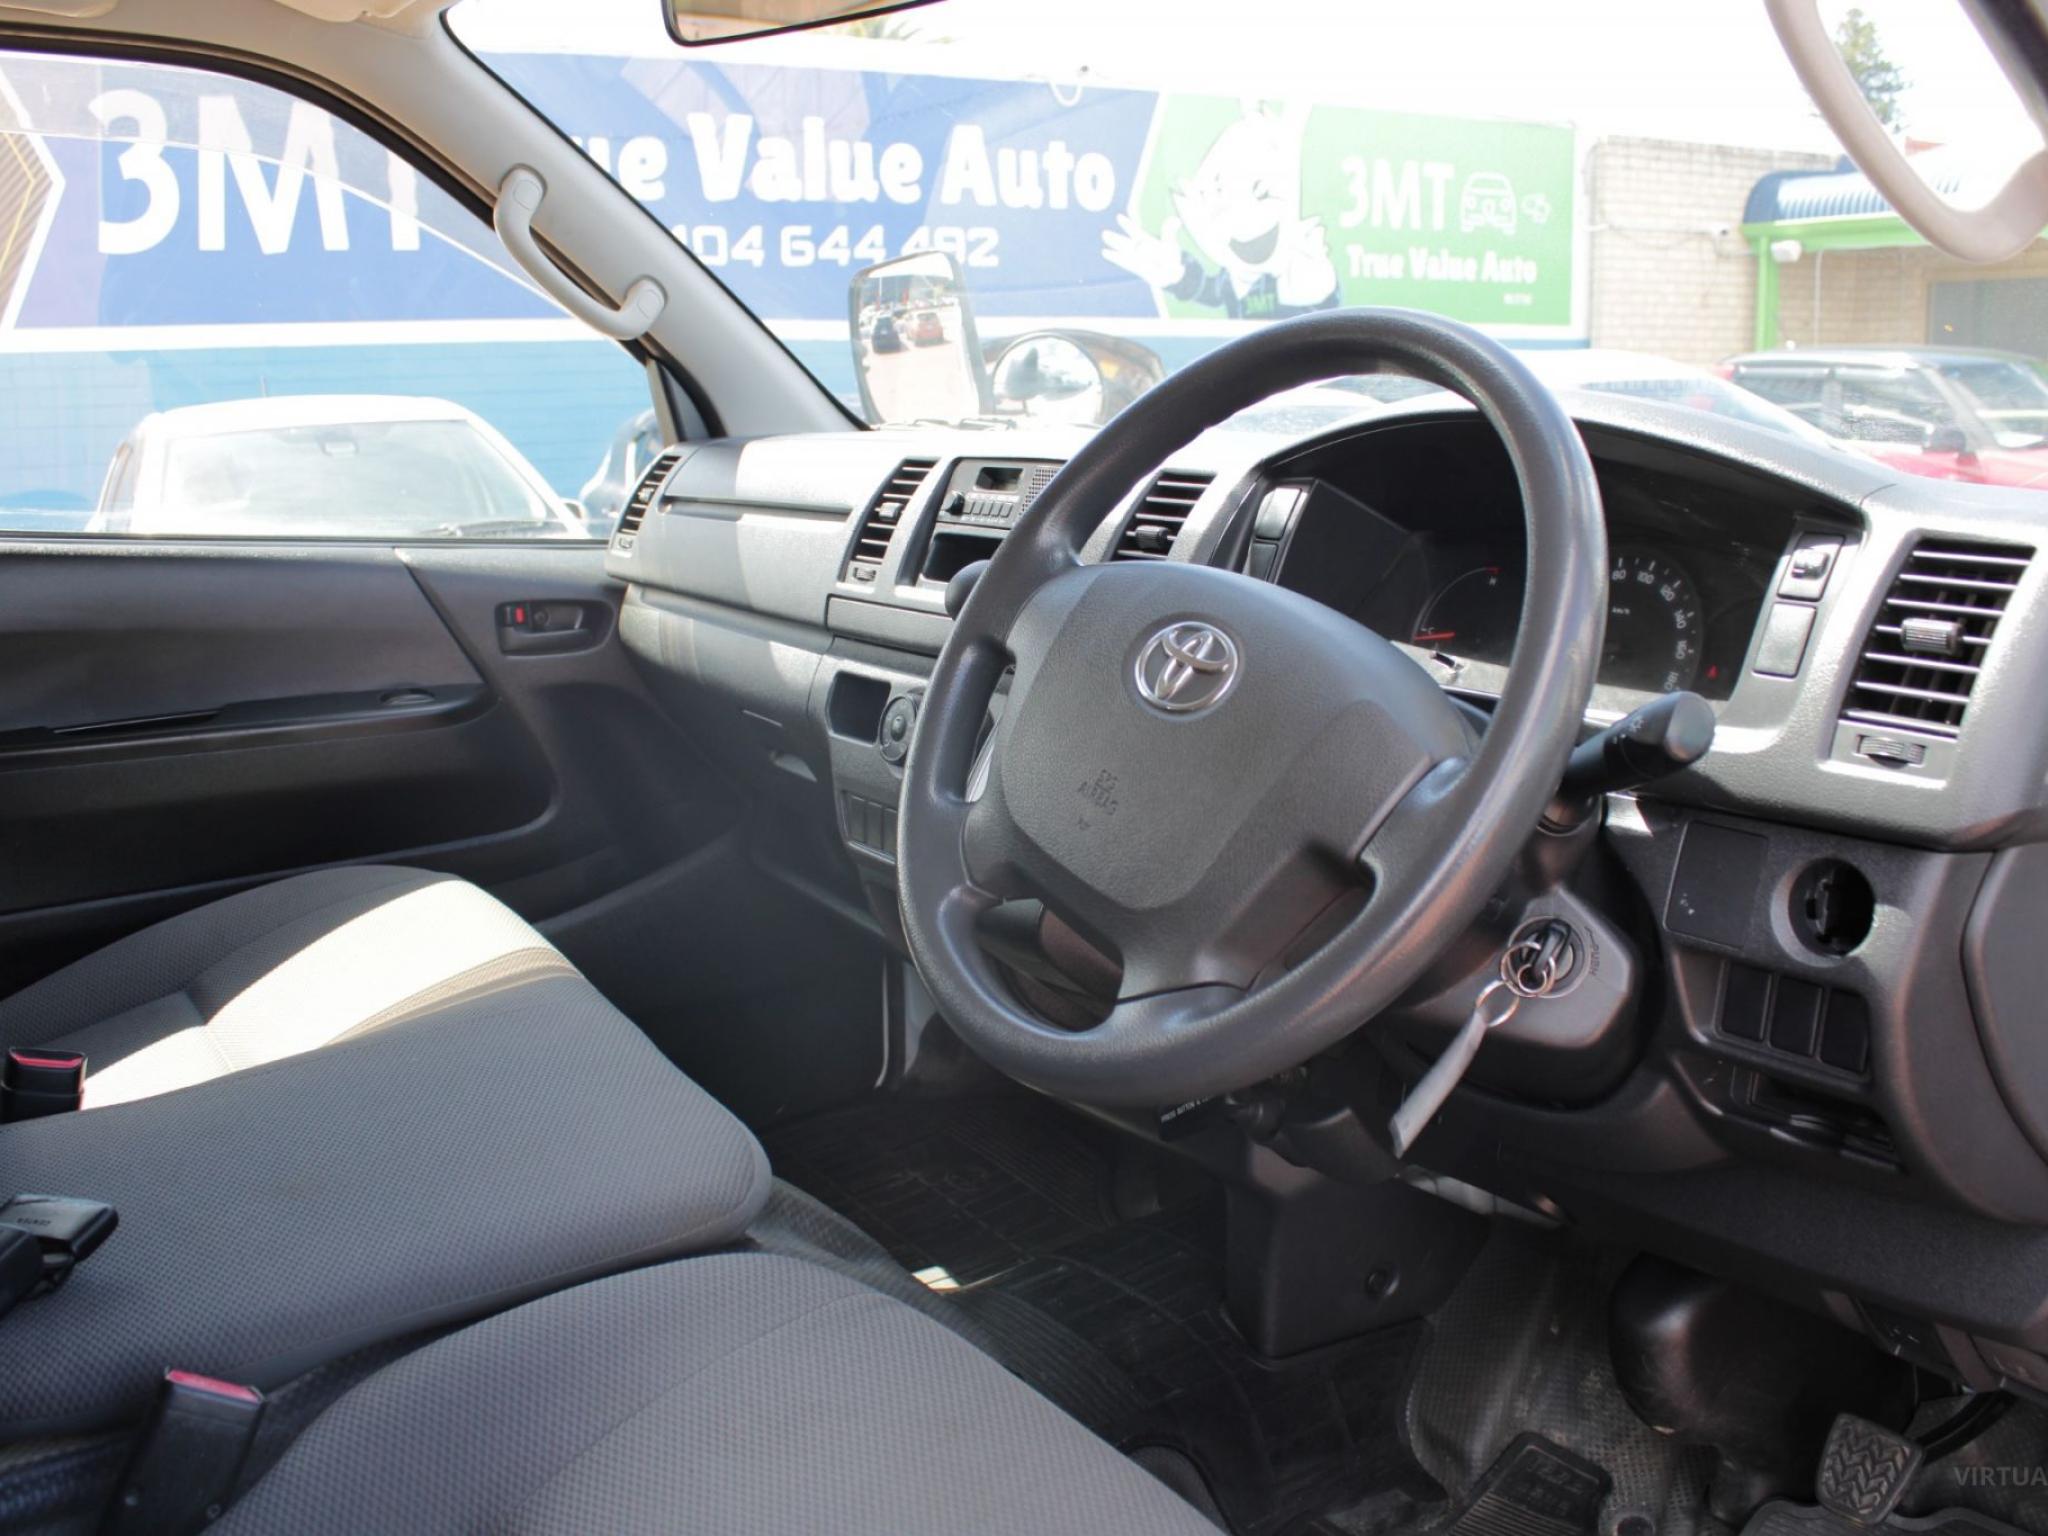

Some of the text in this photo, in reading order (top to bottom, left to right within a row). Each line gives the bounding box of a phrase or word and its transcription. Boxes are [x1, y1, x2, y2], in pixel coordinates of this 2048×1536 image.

[687, 111, 923, 204] Value
[941, 124, 1116, 212] Auto
[1340, 155, 1455, 232] 3MT
[780, 224, 887, 267] 644
[900, 225, 999, 267] 492
[1346, 244, 1538, 284] True Value Auto
[1637, 570, 1655, 585] 100
[1674, 609, 1687, 629] 140
